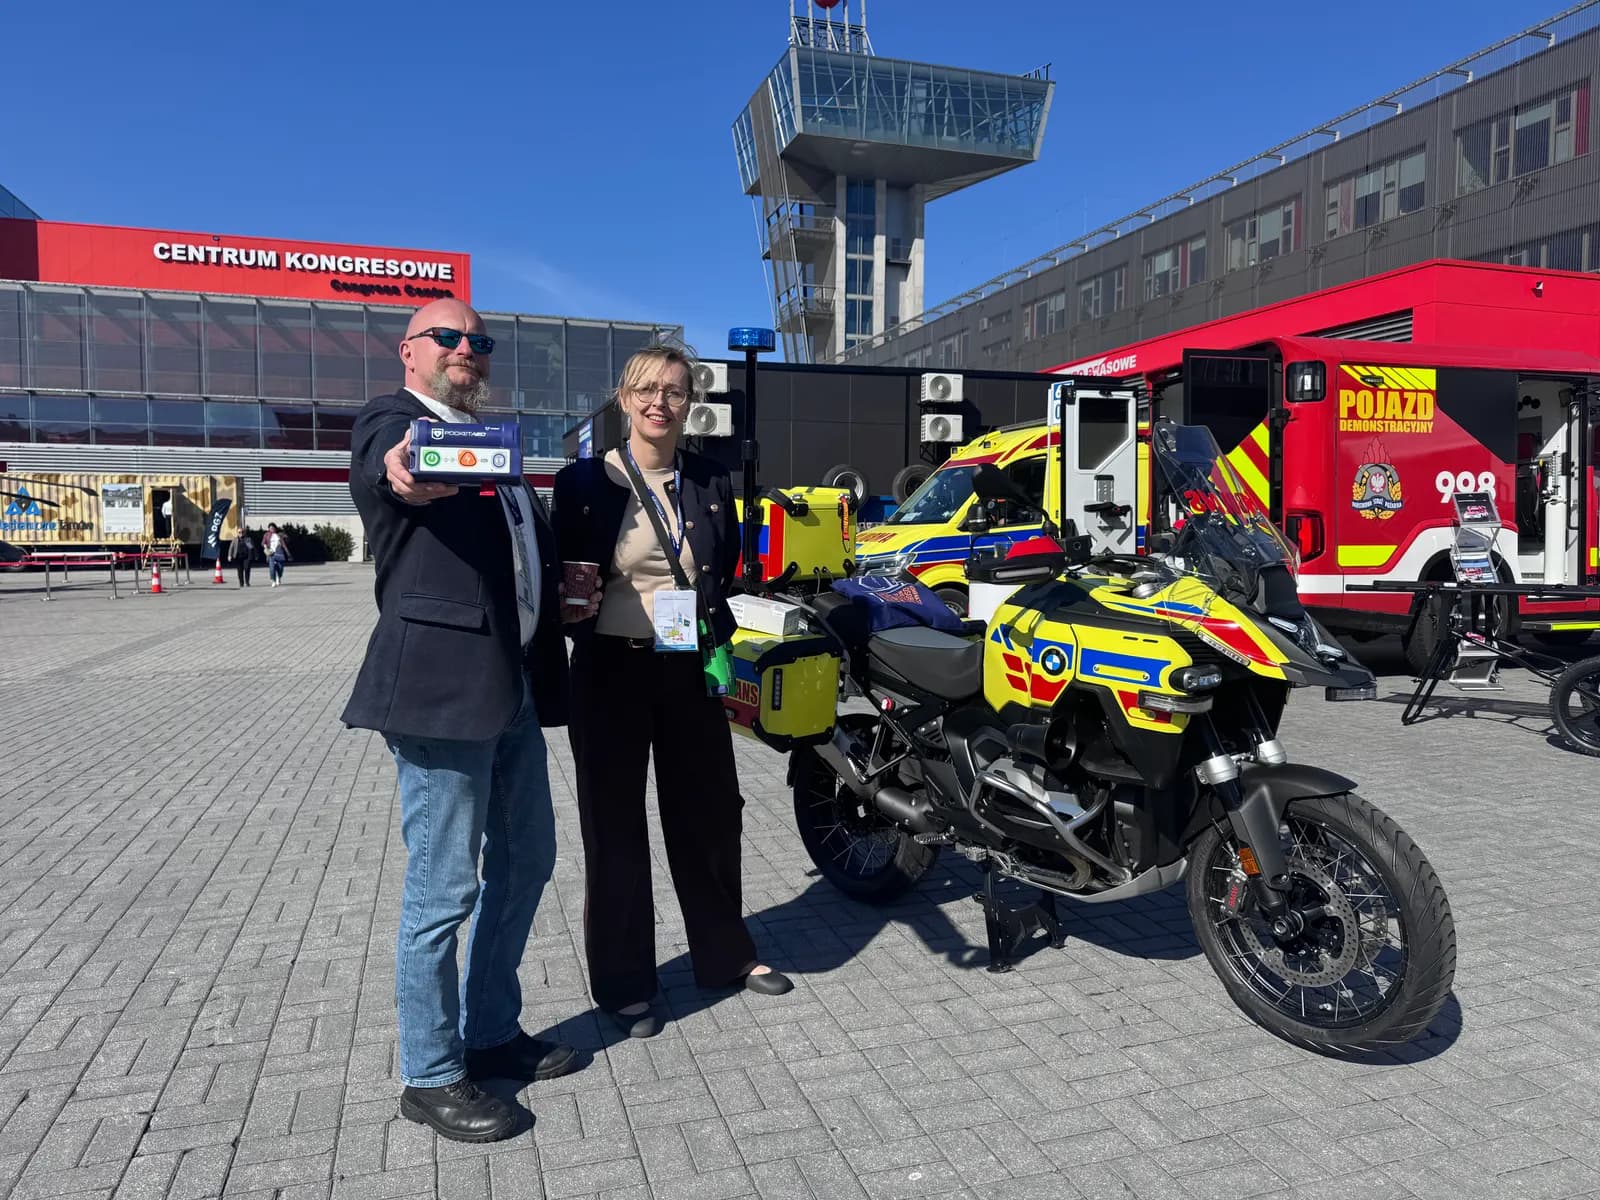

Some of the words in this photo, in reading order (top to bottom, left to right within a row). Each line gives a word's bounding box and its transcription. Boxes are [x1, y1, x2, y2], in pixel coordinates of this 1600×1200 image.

[153, 242, 278, 268] CENTRUM
[285, 252, 453, 280] KONGRESOWE
[1339, 389, 1434, 421] POJAZD
[1339, 420, 1434, 433] DEMONSTRACYJNY
